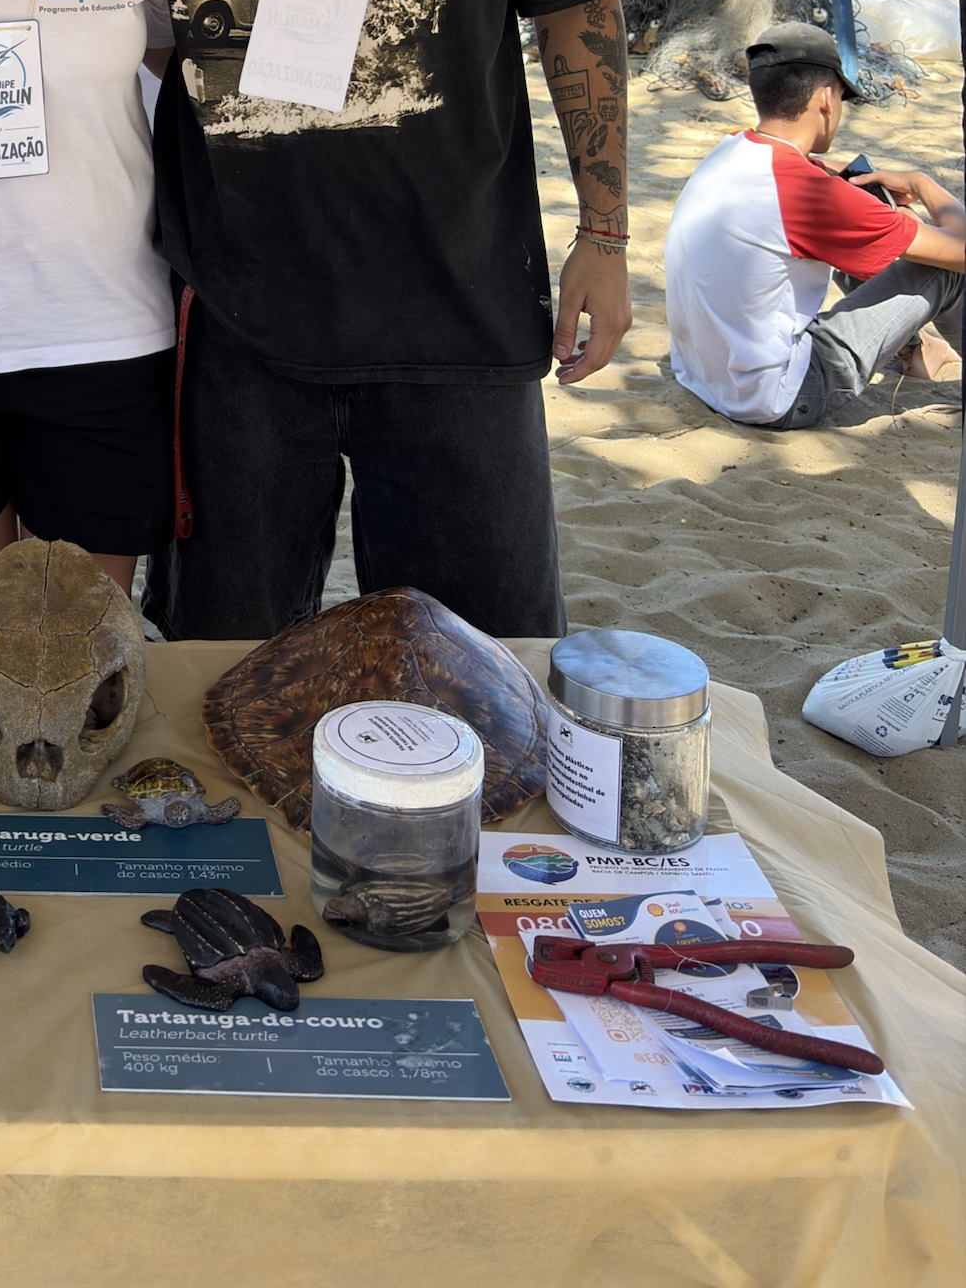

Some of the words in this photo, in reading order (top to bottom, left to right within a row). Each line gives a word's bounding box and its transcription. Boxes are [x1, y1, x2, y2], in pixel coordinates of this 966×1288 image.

[39, 6, 77, 14] Programa
[92, 3, 126, 11] Educação
[565, 753, 594, 773] plásticos
[579, 773, 588, 781] no
[566, 784, 596, 804] marinhas
[595, 788, 605, 796] de
[2, 842, 43, 852] turtle
[116, 862, 183, 871] Tamanho
[187, 862, 245, 872] máximo
[586, 856, 691, 867] PMP-BC/ES
[117, 870, 137, 879] do
[139, 871, 184, 880] casco:
[189, 870, 231, 880] 1,43m
[504, 898, 568, 907] RESGATE
[578, 908, 607, 919] QUEM
[584, 915, 626, 929] SOMOS?
[117, 1009, 384, 1030] Tartaruga-de-couro
[119, 1028, 226, 1041] Leatherback
[232, 1030, 279, 1042] turtle
[123, 1052, 162, 1063] Peso
[166, 1052, 221, 1064] médio:
[312, 1056, 391, 1068] Tamanho
[396, 1057, 462, 1069] imo
[123, 1063, 154, 1073] 400
[159, 1063, 179, 1076] kg
[317, 1067, 340, 1077] do
[345, 1067, 394, 1078] casco:
